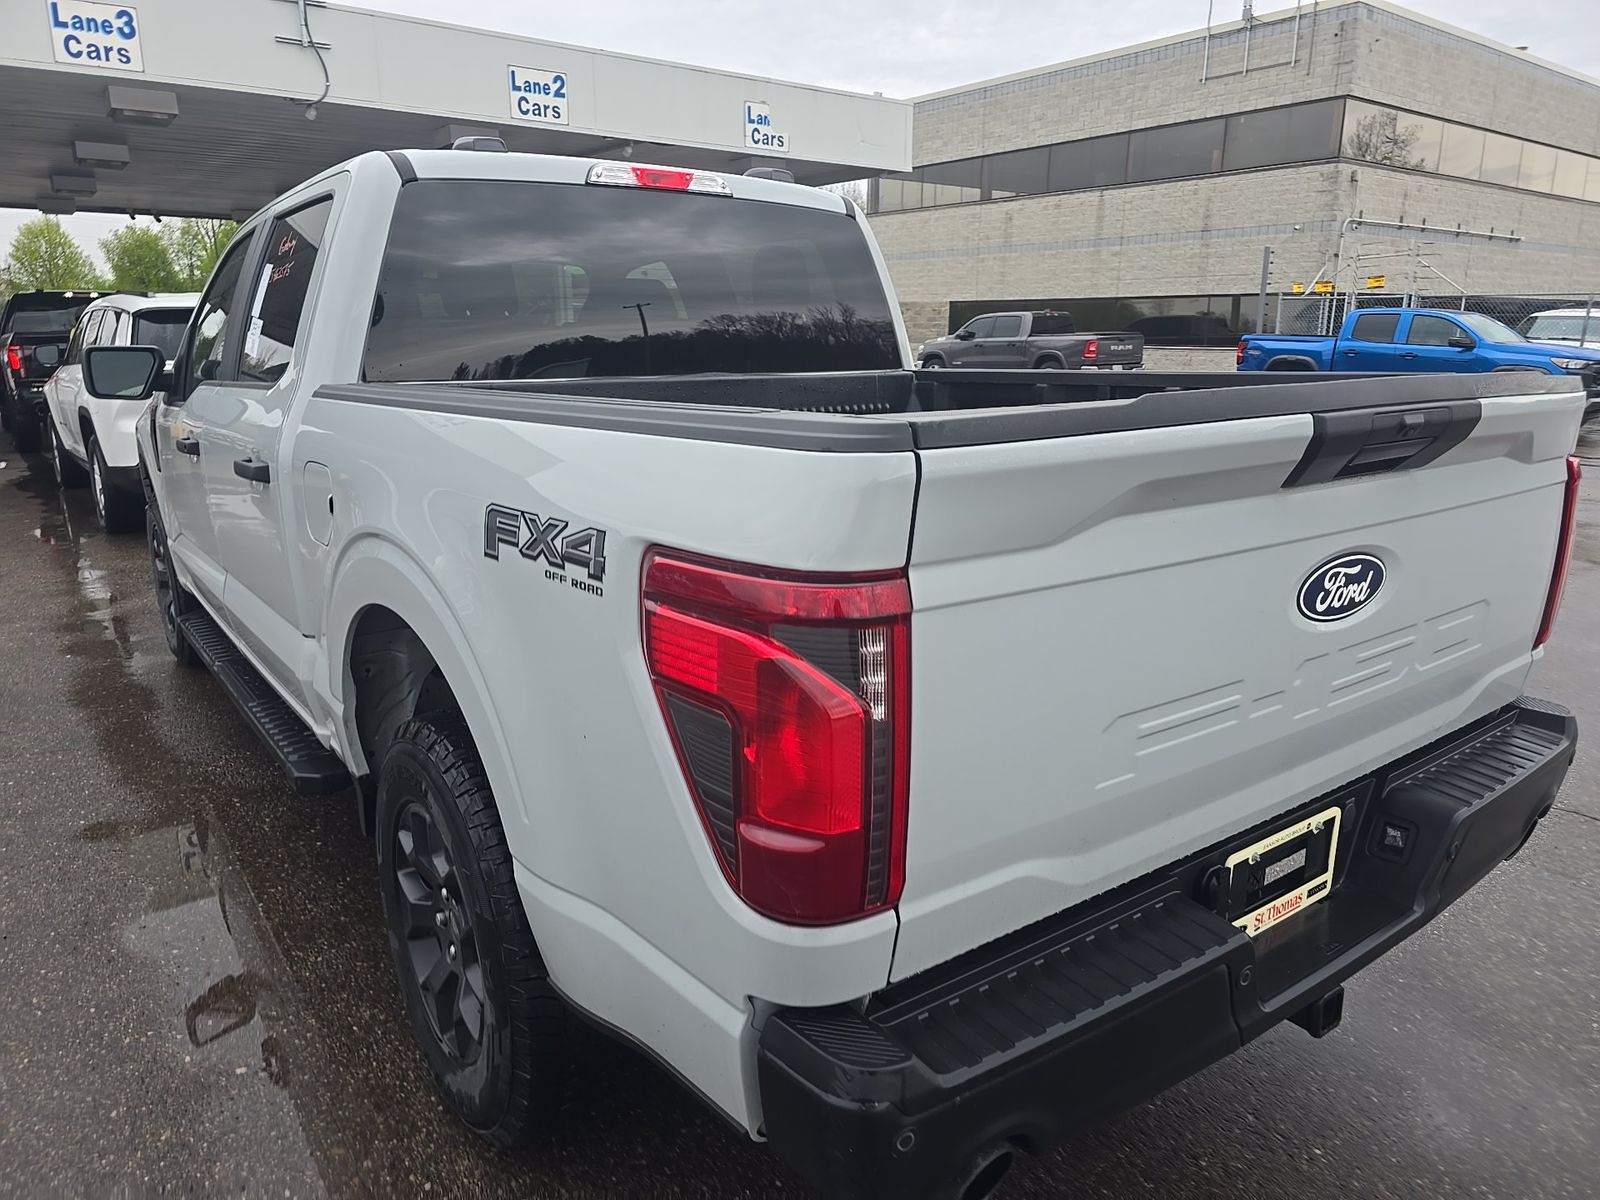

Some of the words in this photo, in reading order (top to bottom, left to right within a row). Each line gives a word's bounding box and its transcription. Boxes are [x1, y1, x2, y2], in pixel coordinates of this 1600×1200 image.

[63, 34, 132, 64] Cars
[518, 96, 561, 119] Cars
[751, 127, 785, 148] Cars
[483, 502, 607, 584] FX4
[544, 569, 568, 584] OFF
[571, 577, 604, 598] ROAD
[1315, 563, 1374, 613] Ford
[1266, 892, 1303, 922] Thomas
